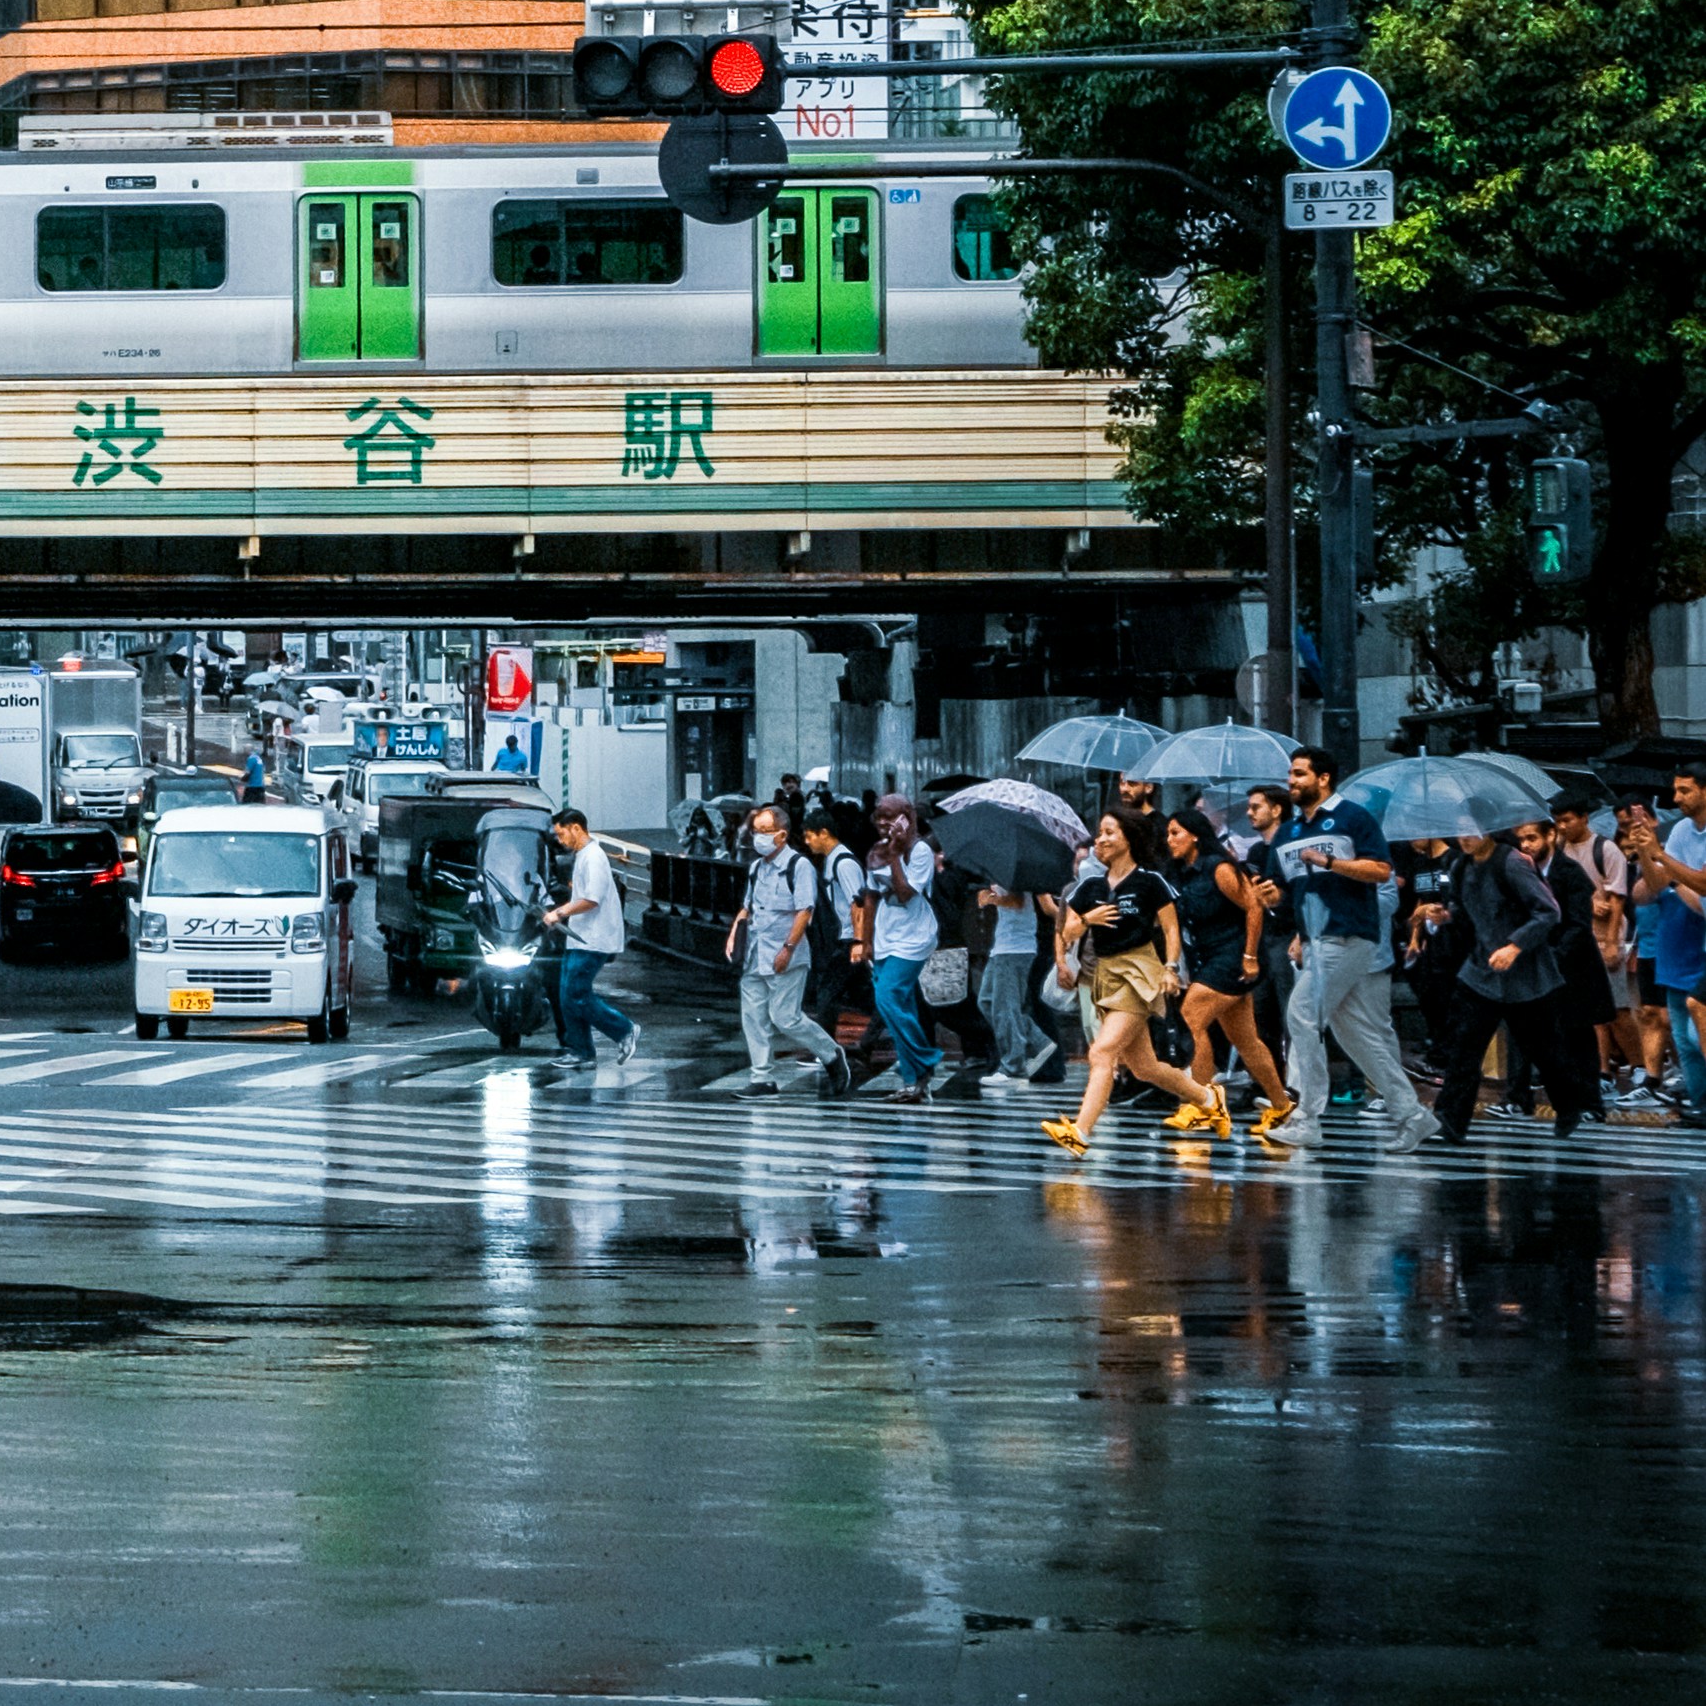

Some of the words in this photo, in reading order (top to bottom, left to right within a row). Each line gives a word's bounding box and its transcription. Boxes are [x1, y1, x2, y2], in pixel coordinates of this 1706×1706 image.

[782, 51, 880, 65] 動産投資
[795, 77, 855, 100] アプリ
[796, 103, 855, 138] No.1
[183, 917, 274, 936] ダイオーズ
